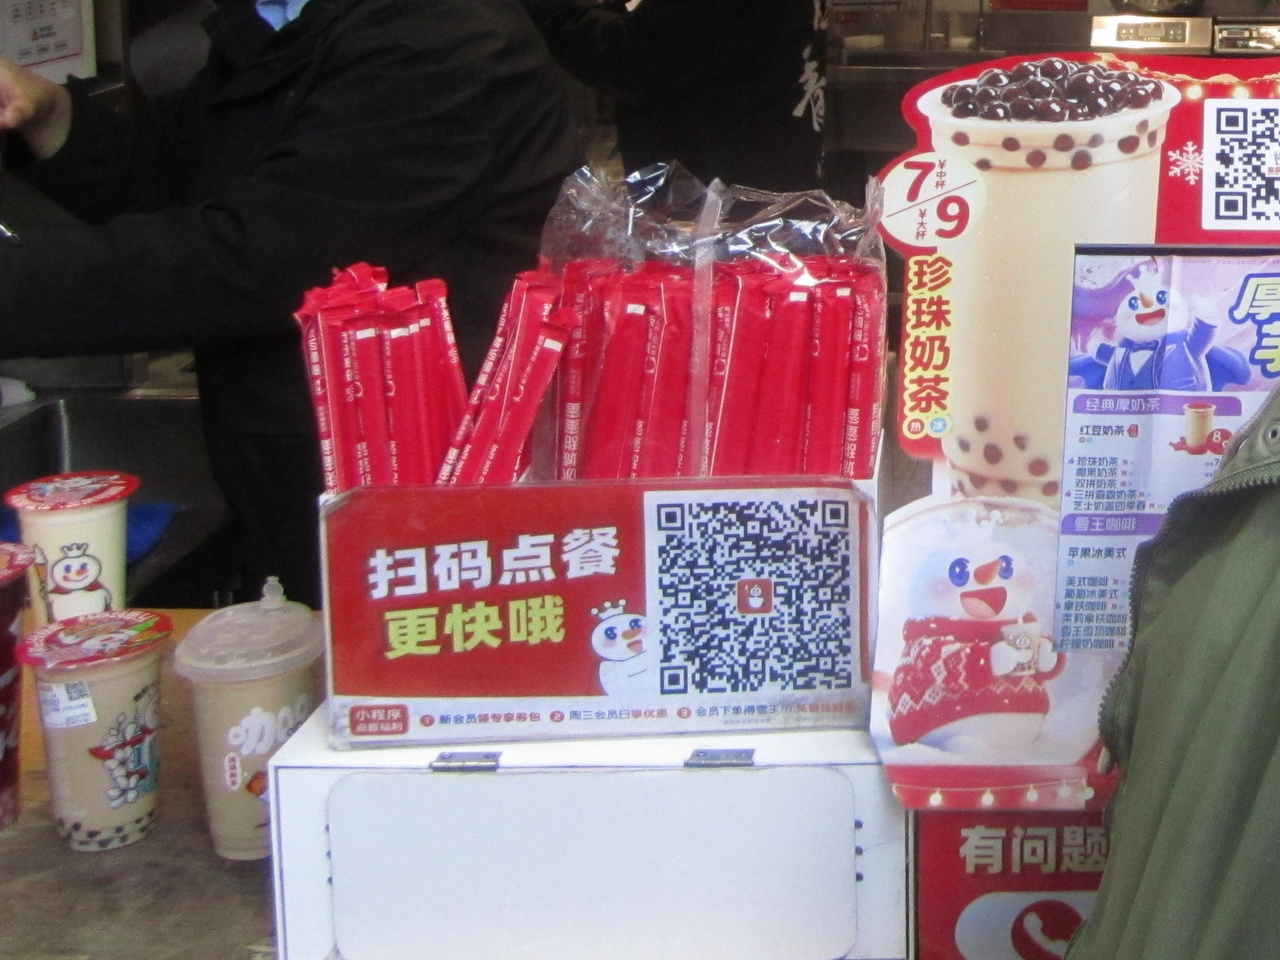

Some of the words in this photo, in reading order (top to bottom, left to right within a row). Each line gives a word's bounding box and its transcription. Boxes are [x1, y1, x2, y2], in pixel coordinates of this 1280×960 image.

[903, 162, 935, 202] 7
[935, 195, 971, 239] 9
[908, 257, 953, 415] 珍珠奶茶
[1086, 398, 1160, 412] 经典厚奶茶
[1079, 425, 1125, 436] 红豆奶茶
[1077, 456, 1119, 466] 珍珠奶茶
[1074, 516, 1136, 532] 雪王咖啡
[367, 526, 622, 601] 扫码点餐
[383, 595, 567, 662] 更快哦
